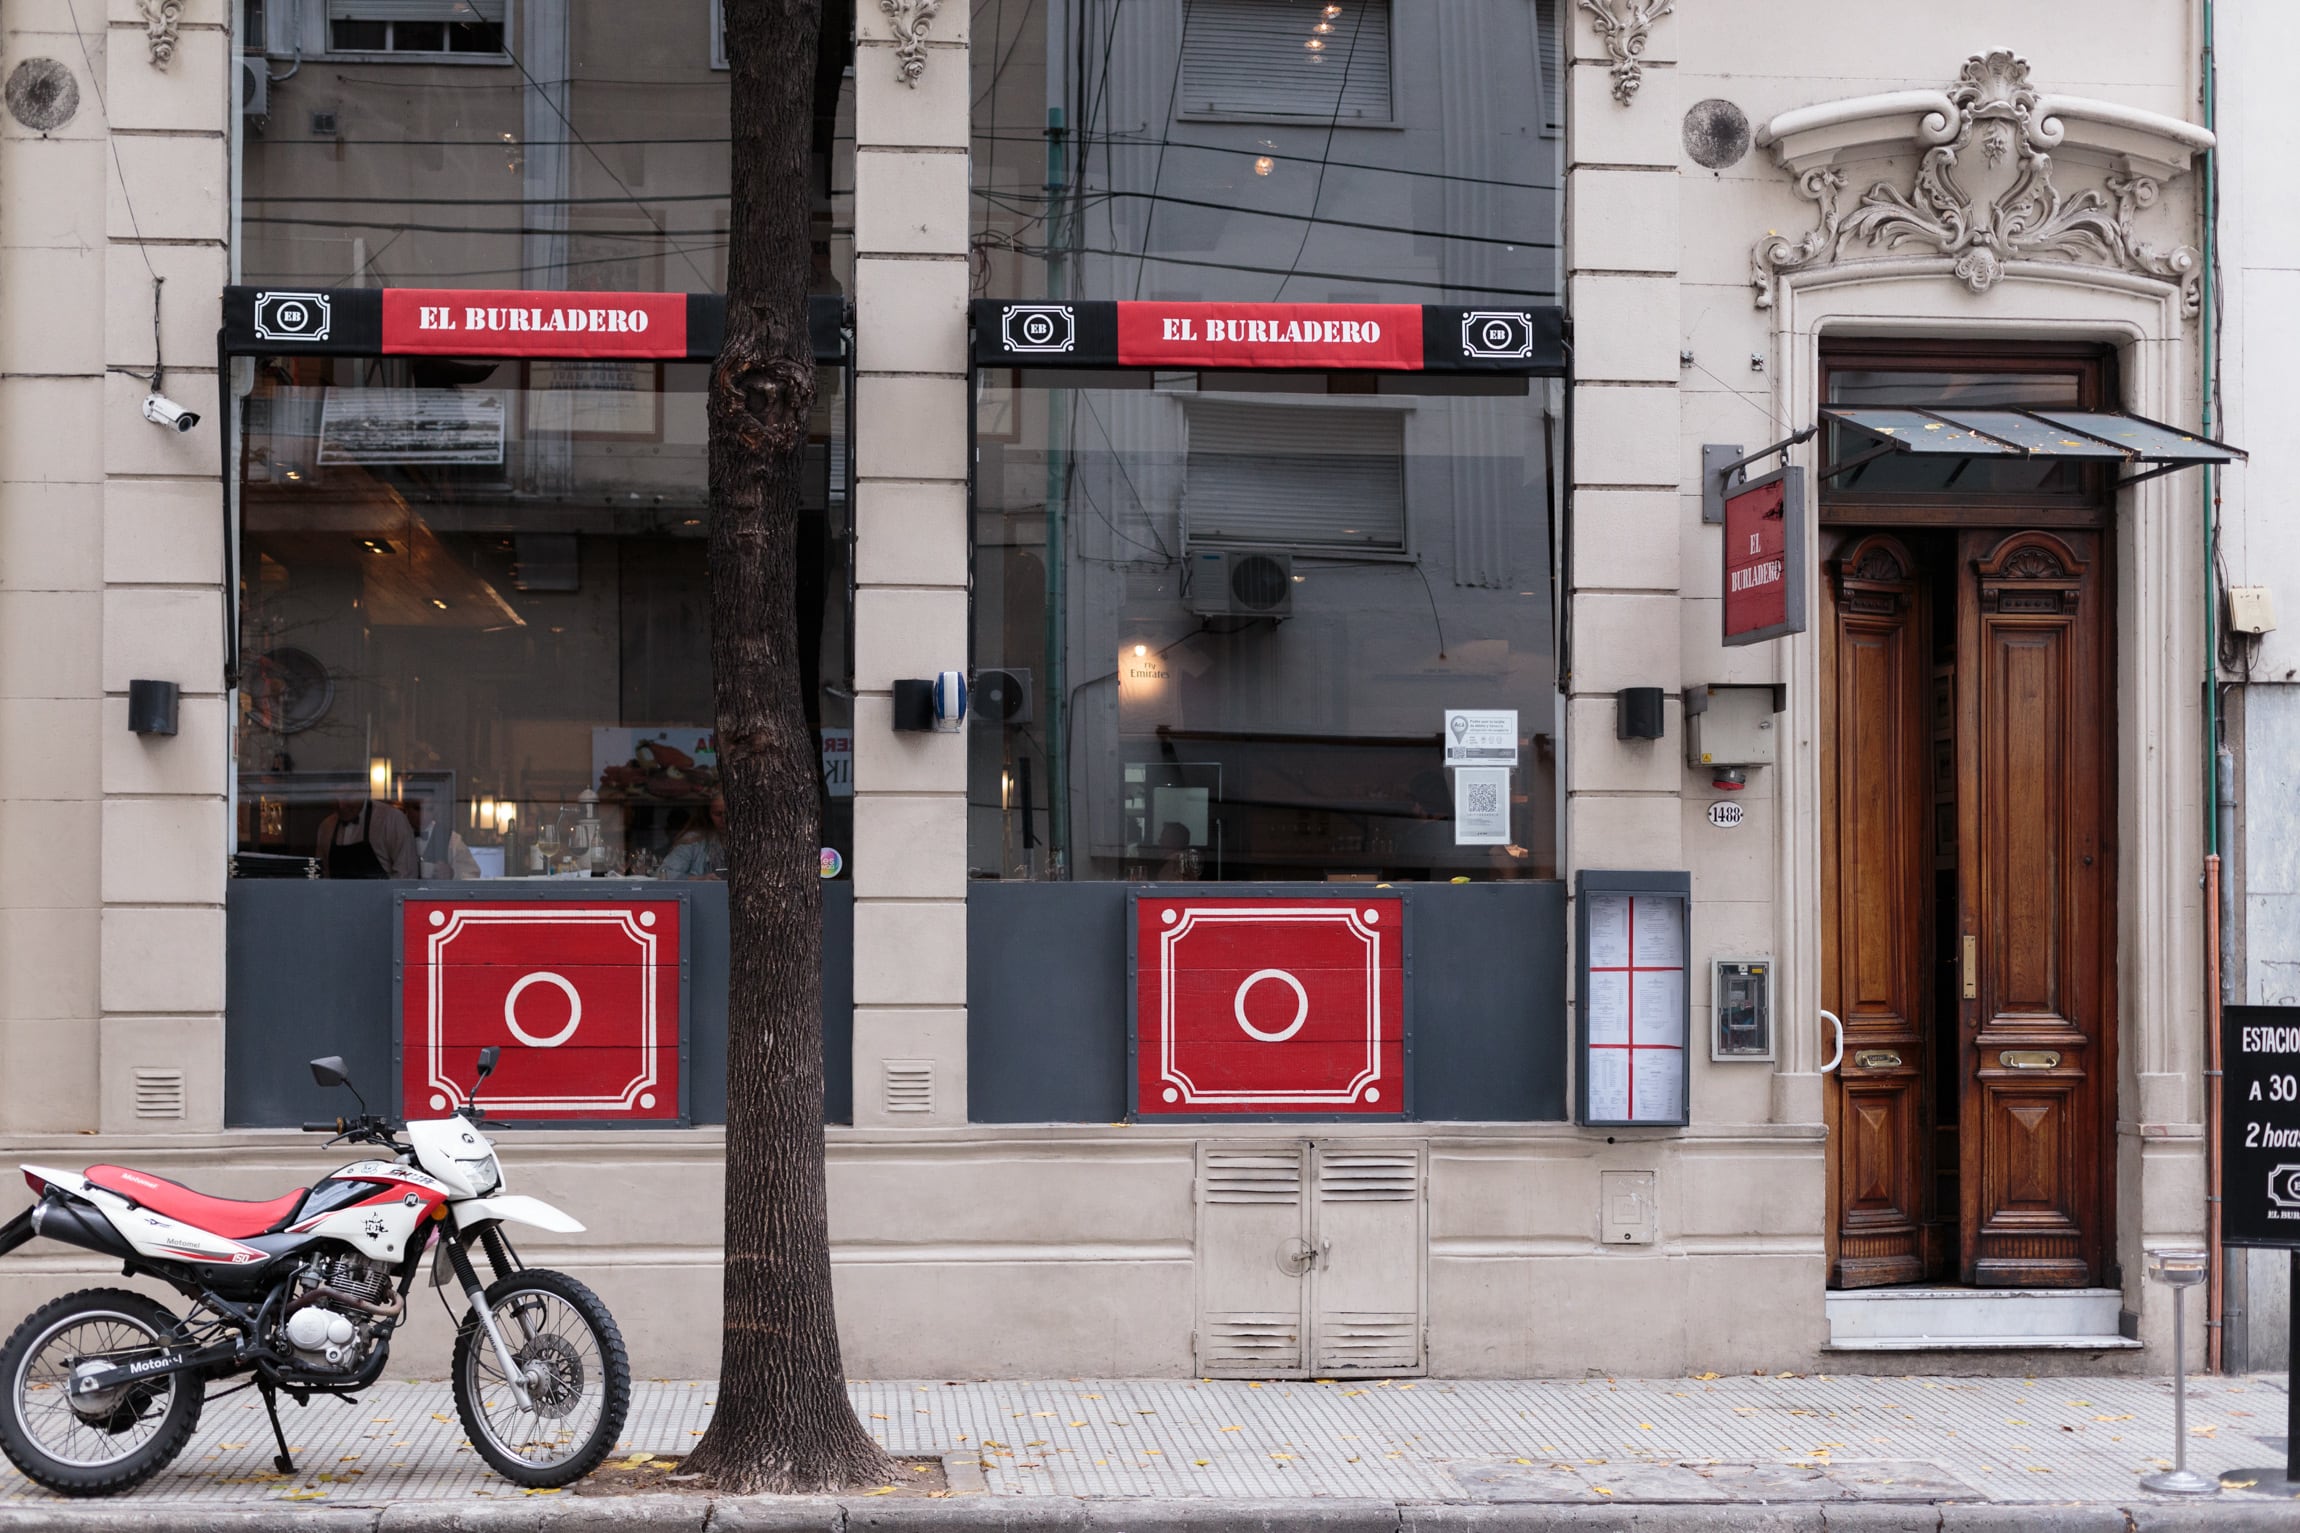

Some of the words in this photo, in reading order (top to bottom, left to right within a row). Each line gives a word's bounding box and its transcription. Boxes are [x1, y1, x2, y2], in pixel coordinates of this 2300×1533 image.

[284, 311, 301, 321] EB
[419, 306, 456, 330] EL
[464, 307, 649, 333] BURLADERO
[1030, 323, 1047, 334] EB
[1162, 318, 1198, 341] EL
[1205, 319, 1381, 344] BURLADERO
[1489, 329, 1506, 340] EB
[1750, 533, 1761, 555] EL
[1731, 560, 1782, 592] BURLADERO
[1130, 669, 1170, 679] Emirates
[1713, 807, 1741, 822] 1488
[2242, 1026, 2300, 1053] ESTACIO
[2248, 1080, 2262, 1101] A
[2269, 1074, 2297, 1102] 30
[2245, 1122, 2260, 1148] 2
[166, 1238, 200, 1249] Motomel
[232, 1253, 250, 1264] 150
